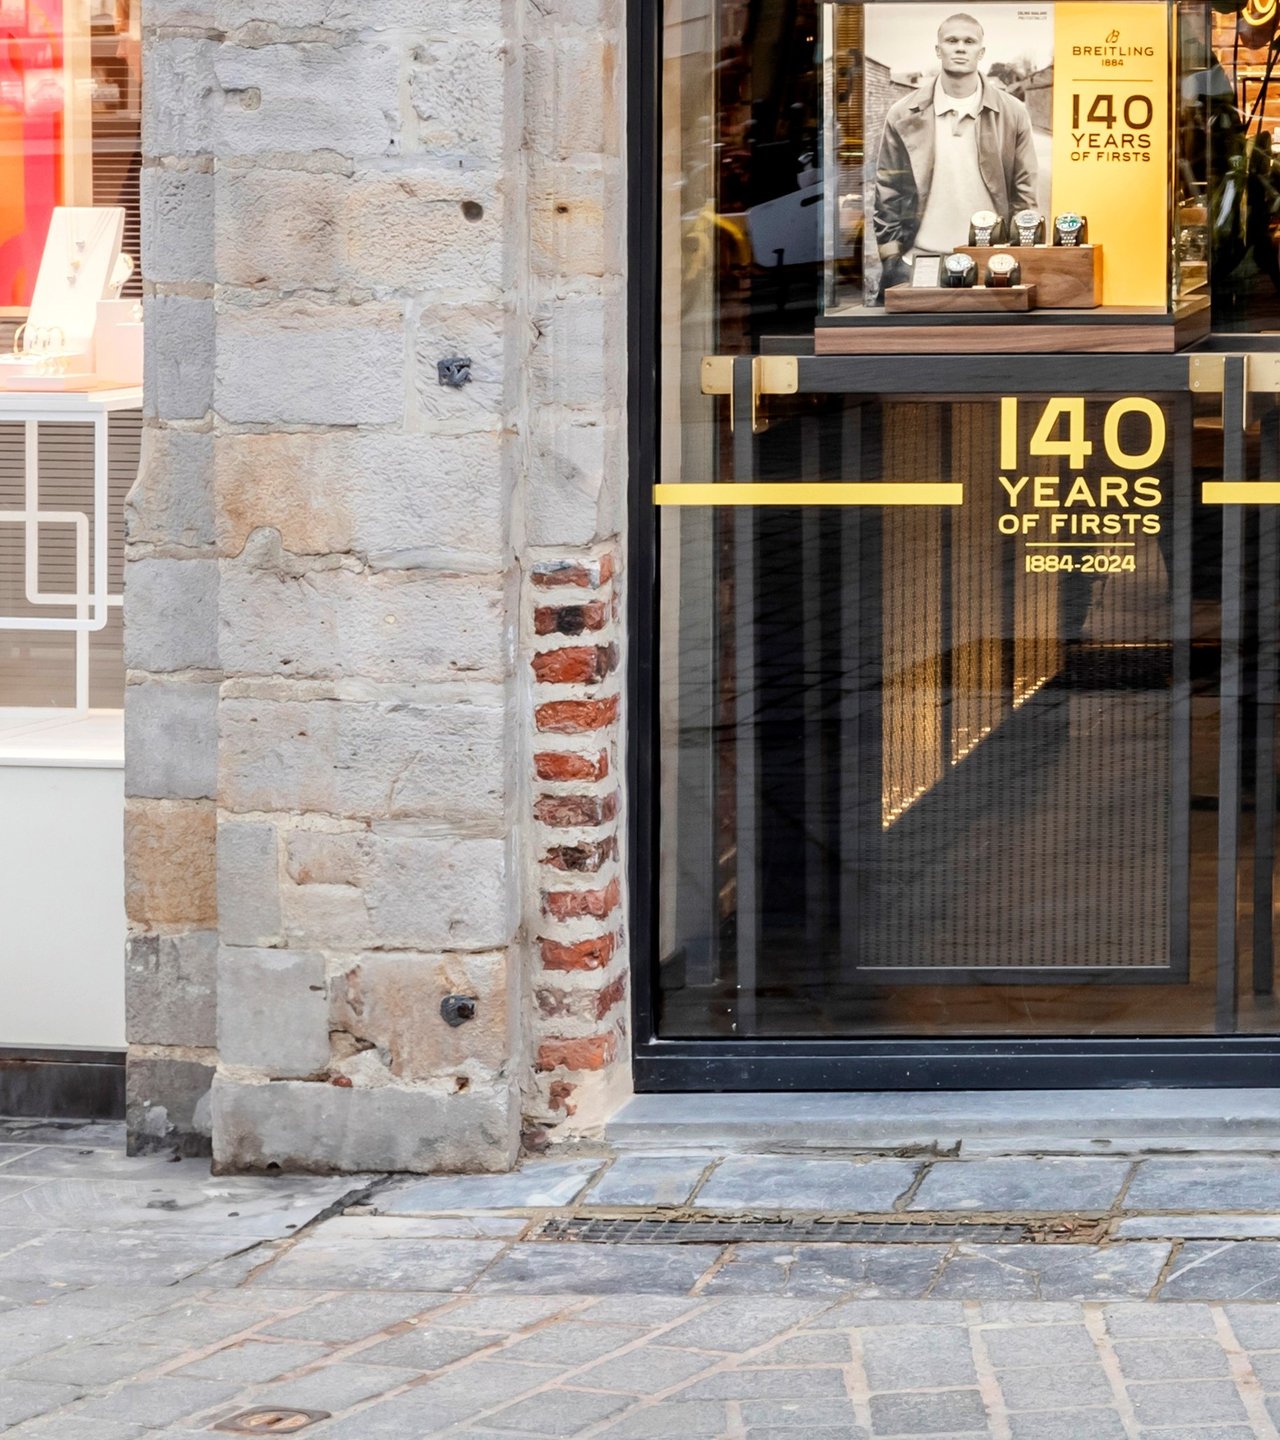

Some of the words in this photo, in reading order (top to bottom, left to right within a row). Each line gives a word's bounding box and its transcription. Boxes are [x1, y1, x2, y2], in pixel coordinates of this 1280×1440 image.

[1072, 46, 1154, 57] BREITLING
[1101, 58, 1124, 66] 1884
[1072, 93, 1153, 130] 140
[1071, 133, 1152, 149] YEARS
[1071, 151, 1090, 161] OF
[1096, 151, 1151, 162] FIRSTS
[1000, 396, 1166, 470] 140
[998, 476, 1162, 508] YEARS
[998, 513, 1040, 535] OF
[1050, 513, 1161, 535] FIRSTS
[1025, 554, 1136, 573] 1884-2024
